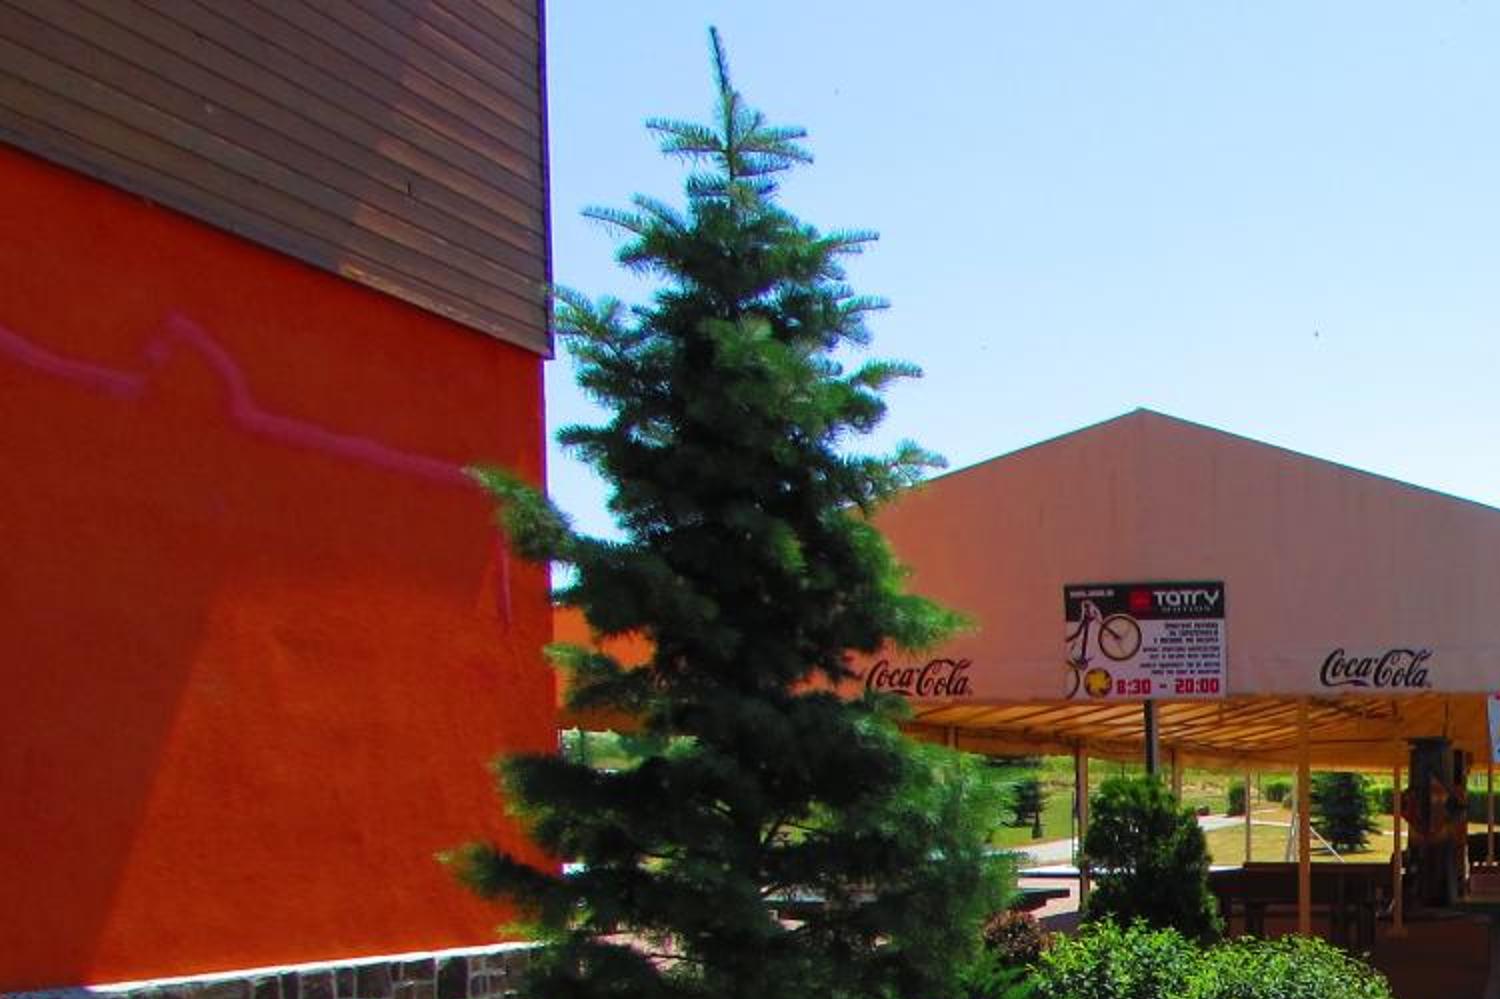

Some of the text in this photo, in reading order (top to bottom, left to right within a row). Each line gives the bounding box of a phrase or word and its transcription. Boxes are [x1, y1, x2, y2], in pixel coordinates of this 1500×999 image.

[866, 658, 974, 697] Coca-Cola
[1116, 678, 1151, 695] 8:30
[1174, 677, 1220, 694] 20:00
[1320, 648, 1432, 688] Coca-Cola
